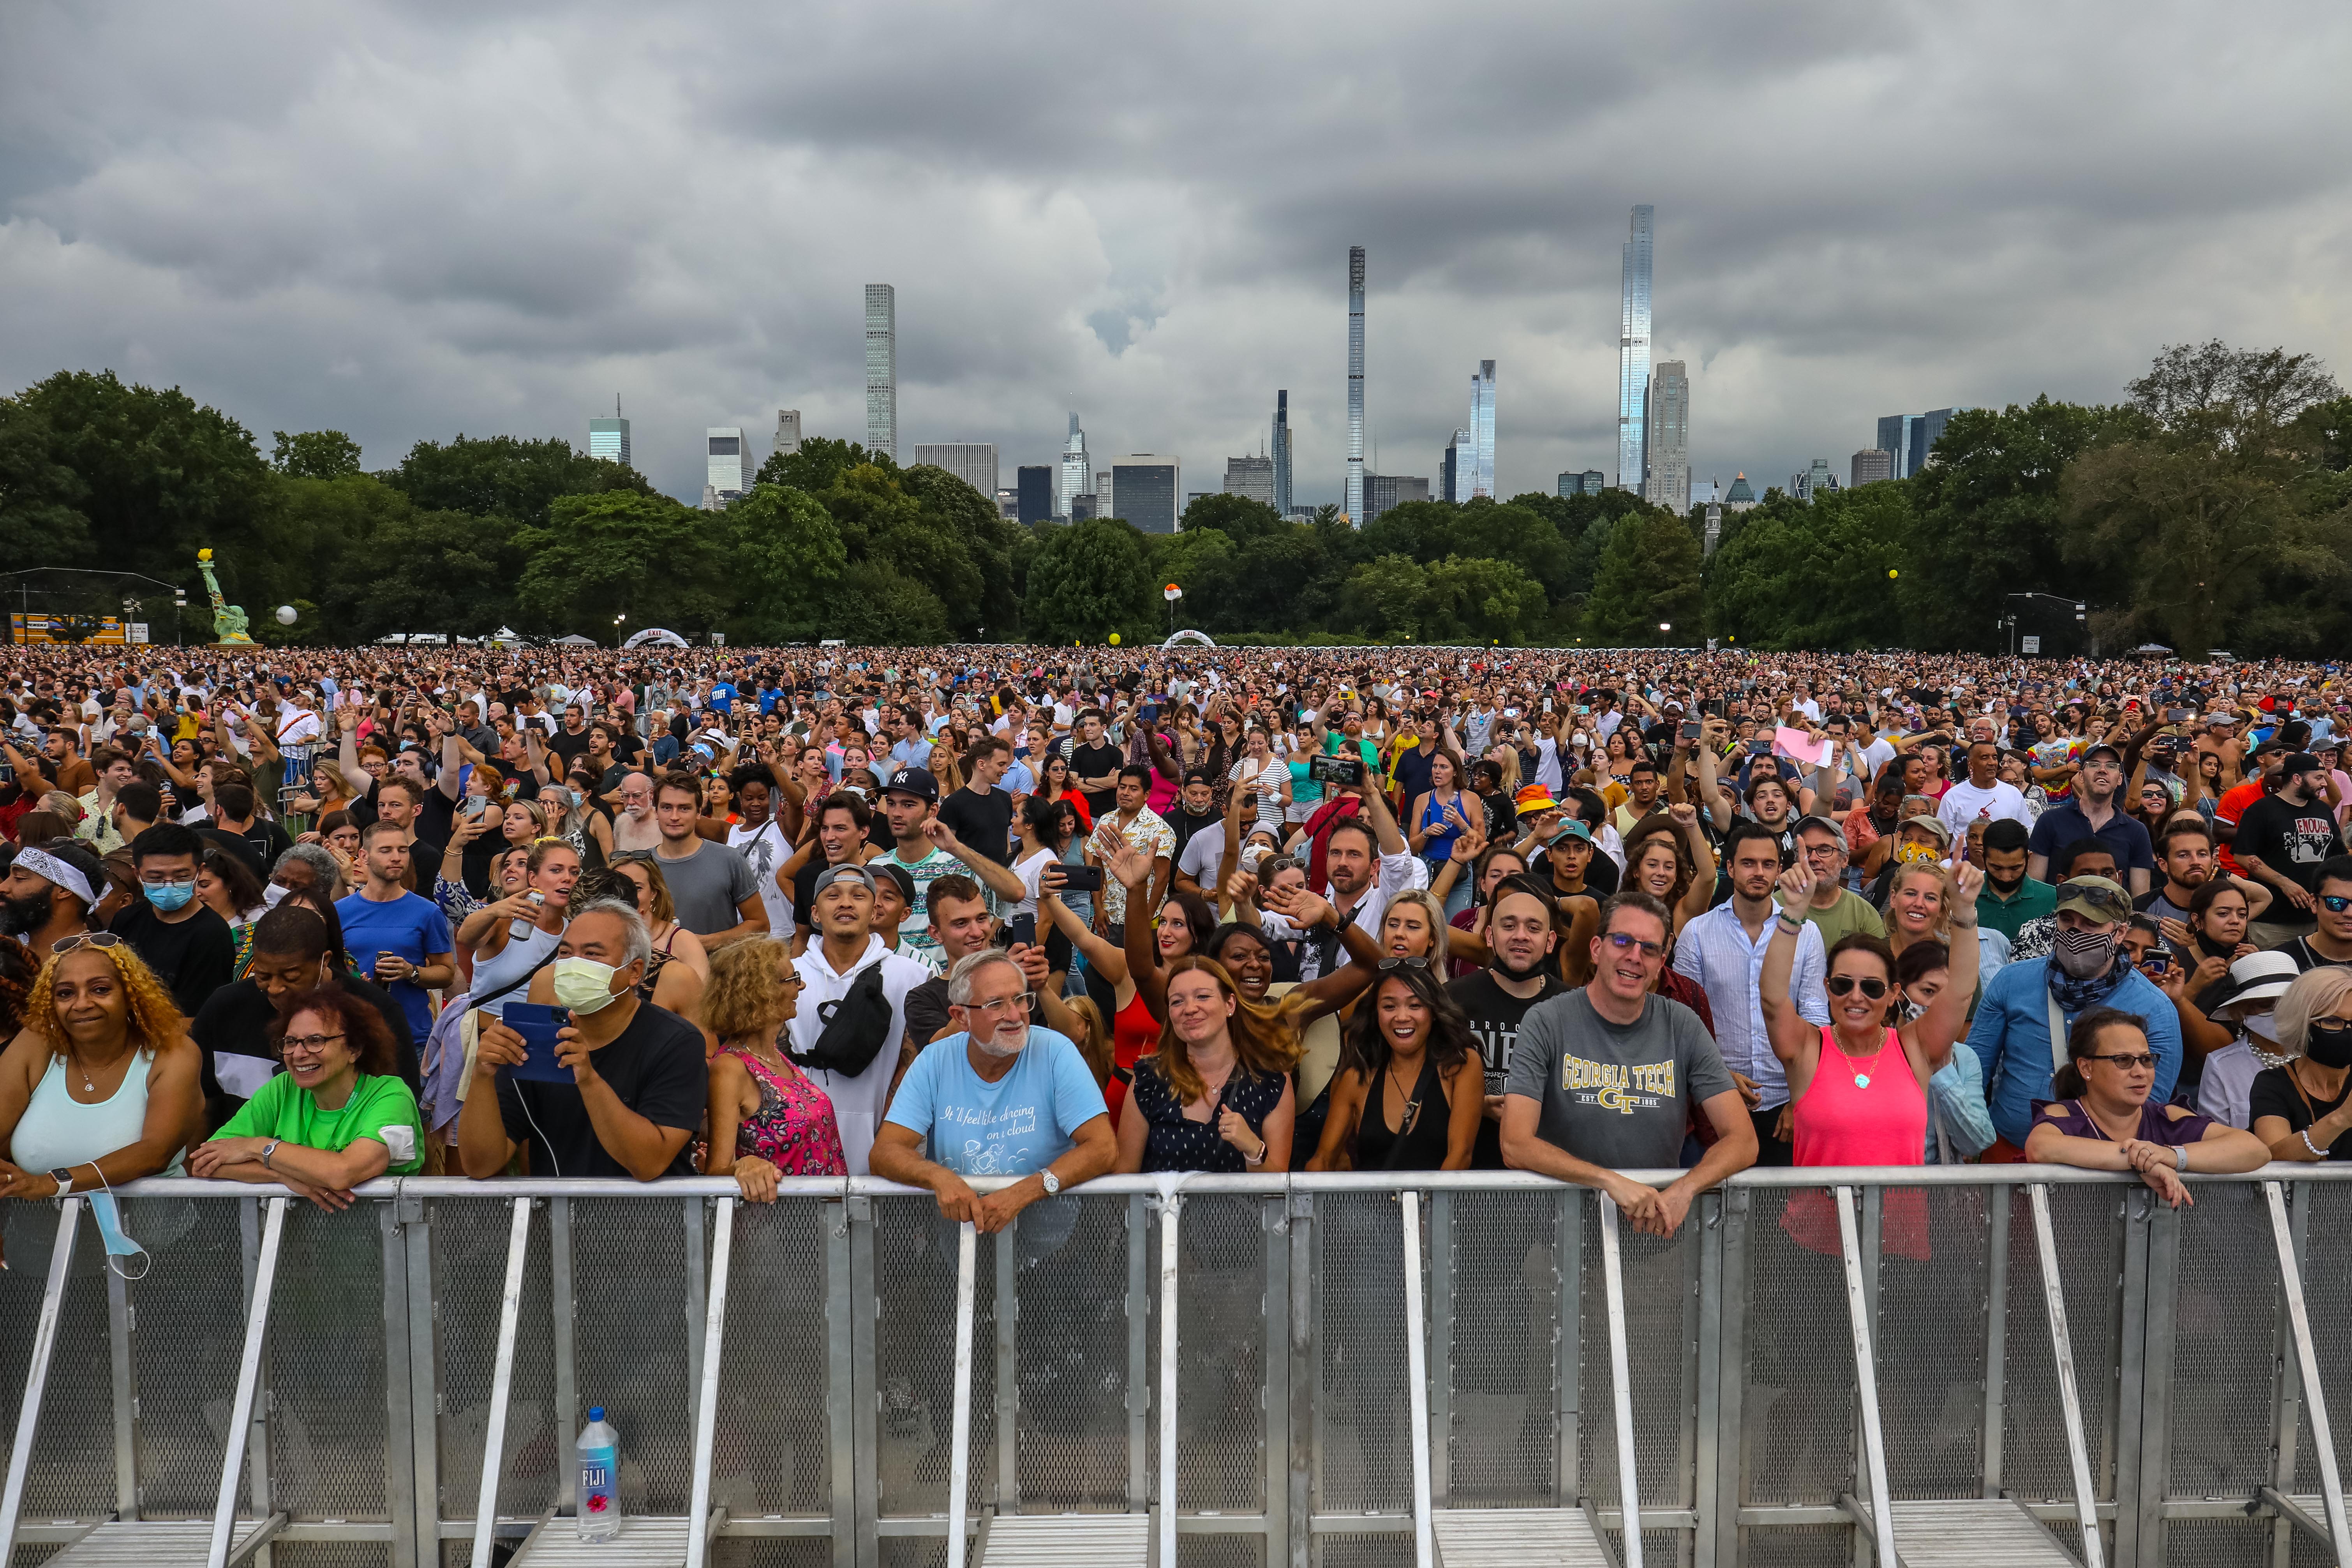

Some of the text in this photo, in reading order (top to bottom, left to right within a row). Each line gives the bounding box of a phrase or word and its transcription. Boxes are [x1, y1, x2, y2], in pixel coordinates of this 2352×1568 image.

[712, 689, 726, 700] STAFF
[894, 771, 908, 783] NY
[2297, 818, 2329, 834] ENOUGH
[1562, 1053, 1675, 1097] GEORGIA TECH
[1597, 1087, 1640, 1114] GT
[961, 1108, 982, 1127] feel
[982, 1109, 997, 1125] like
[987, 1132, 999, 1140] on
[1007, 1115, 1036, 1136] cloud
[583, 1469, 605, 1486] FIJI
